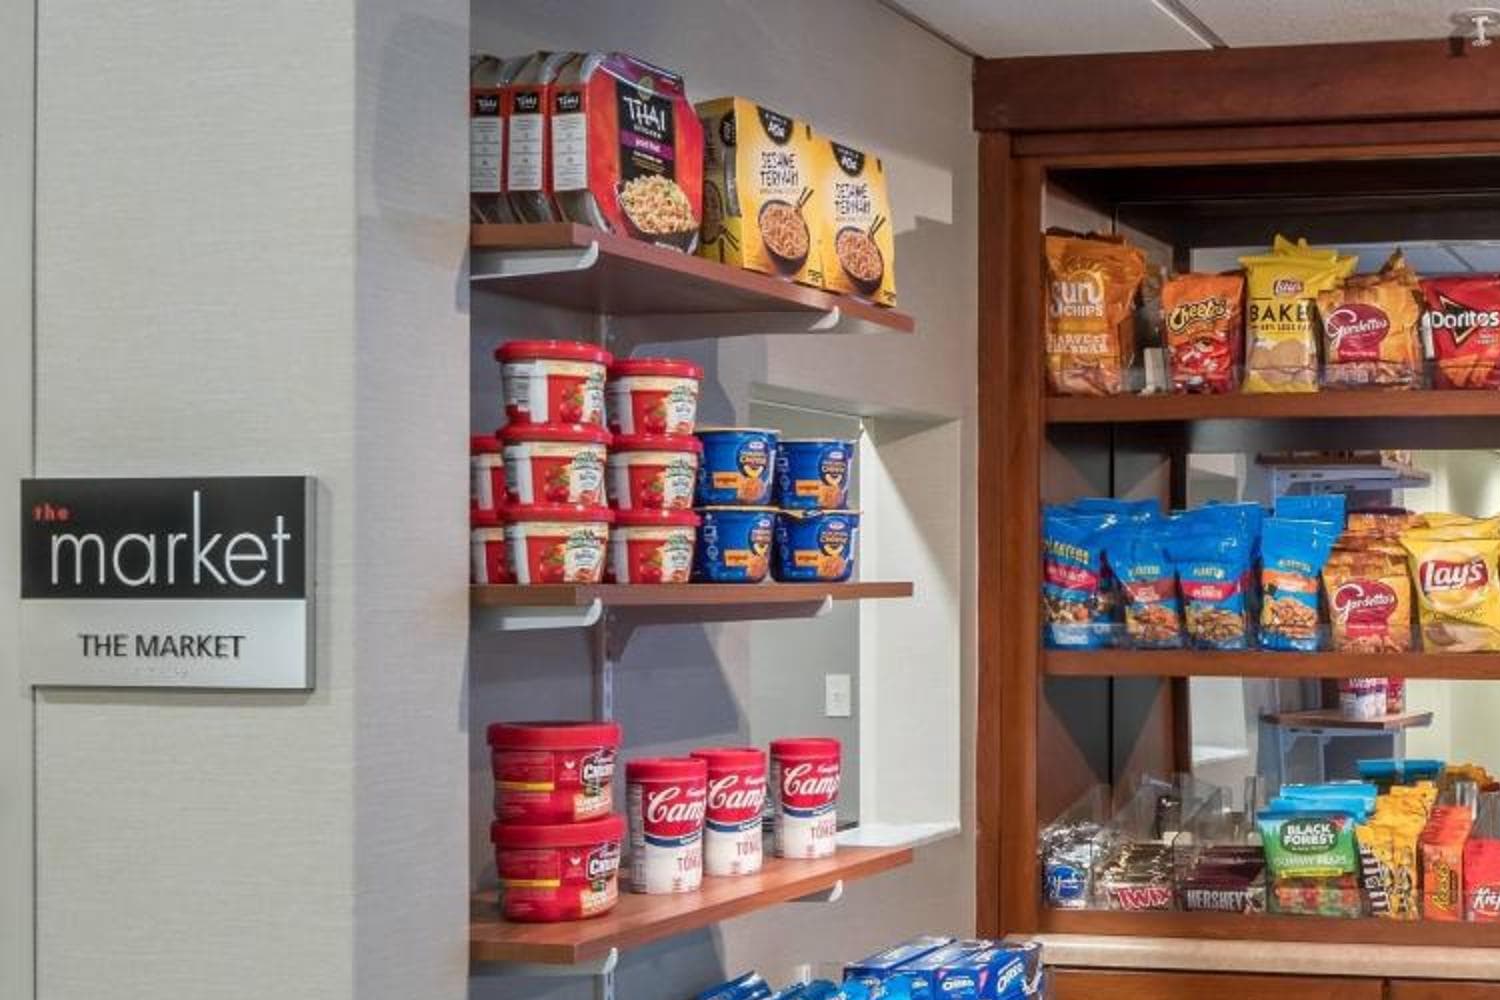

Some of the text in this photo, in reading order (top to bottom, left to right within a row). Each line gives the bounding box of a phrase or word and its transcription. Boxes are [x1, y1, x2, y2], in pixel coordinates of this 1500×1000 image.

[623, 96, 666, 132] THAI
[1169, 296, 1228, 332] Cheetos
[1249, 303, 1307, 323] BAKE
[1431, 310, 1500, 329] Doritos
[31, 503, 70, 521] the
[50, 489, 292, 587] market
[1423, 562, 1484, 592] Lay's
[78, 633, 245, 659] THE MARKET
[1283, 834, 1336, 846] FOREST
[1287, 823, 1331, 835] BLACK
[1118, 886, 1173, 911] TWIX
